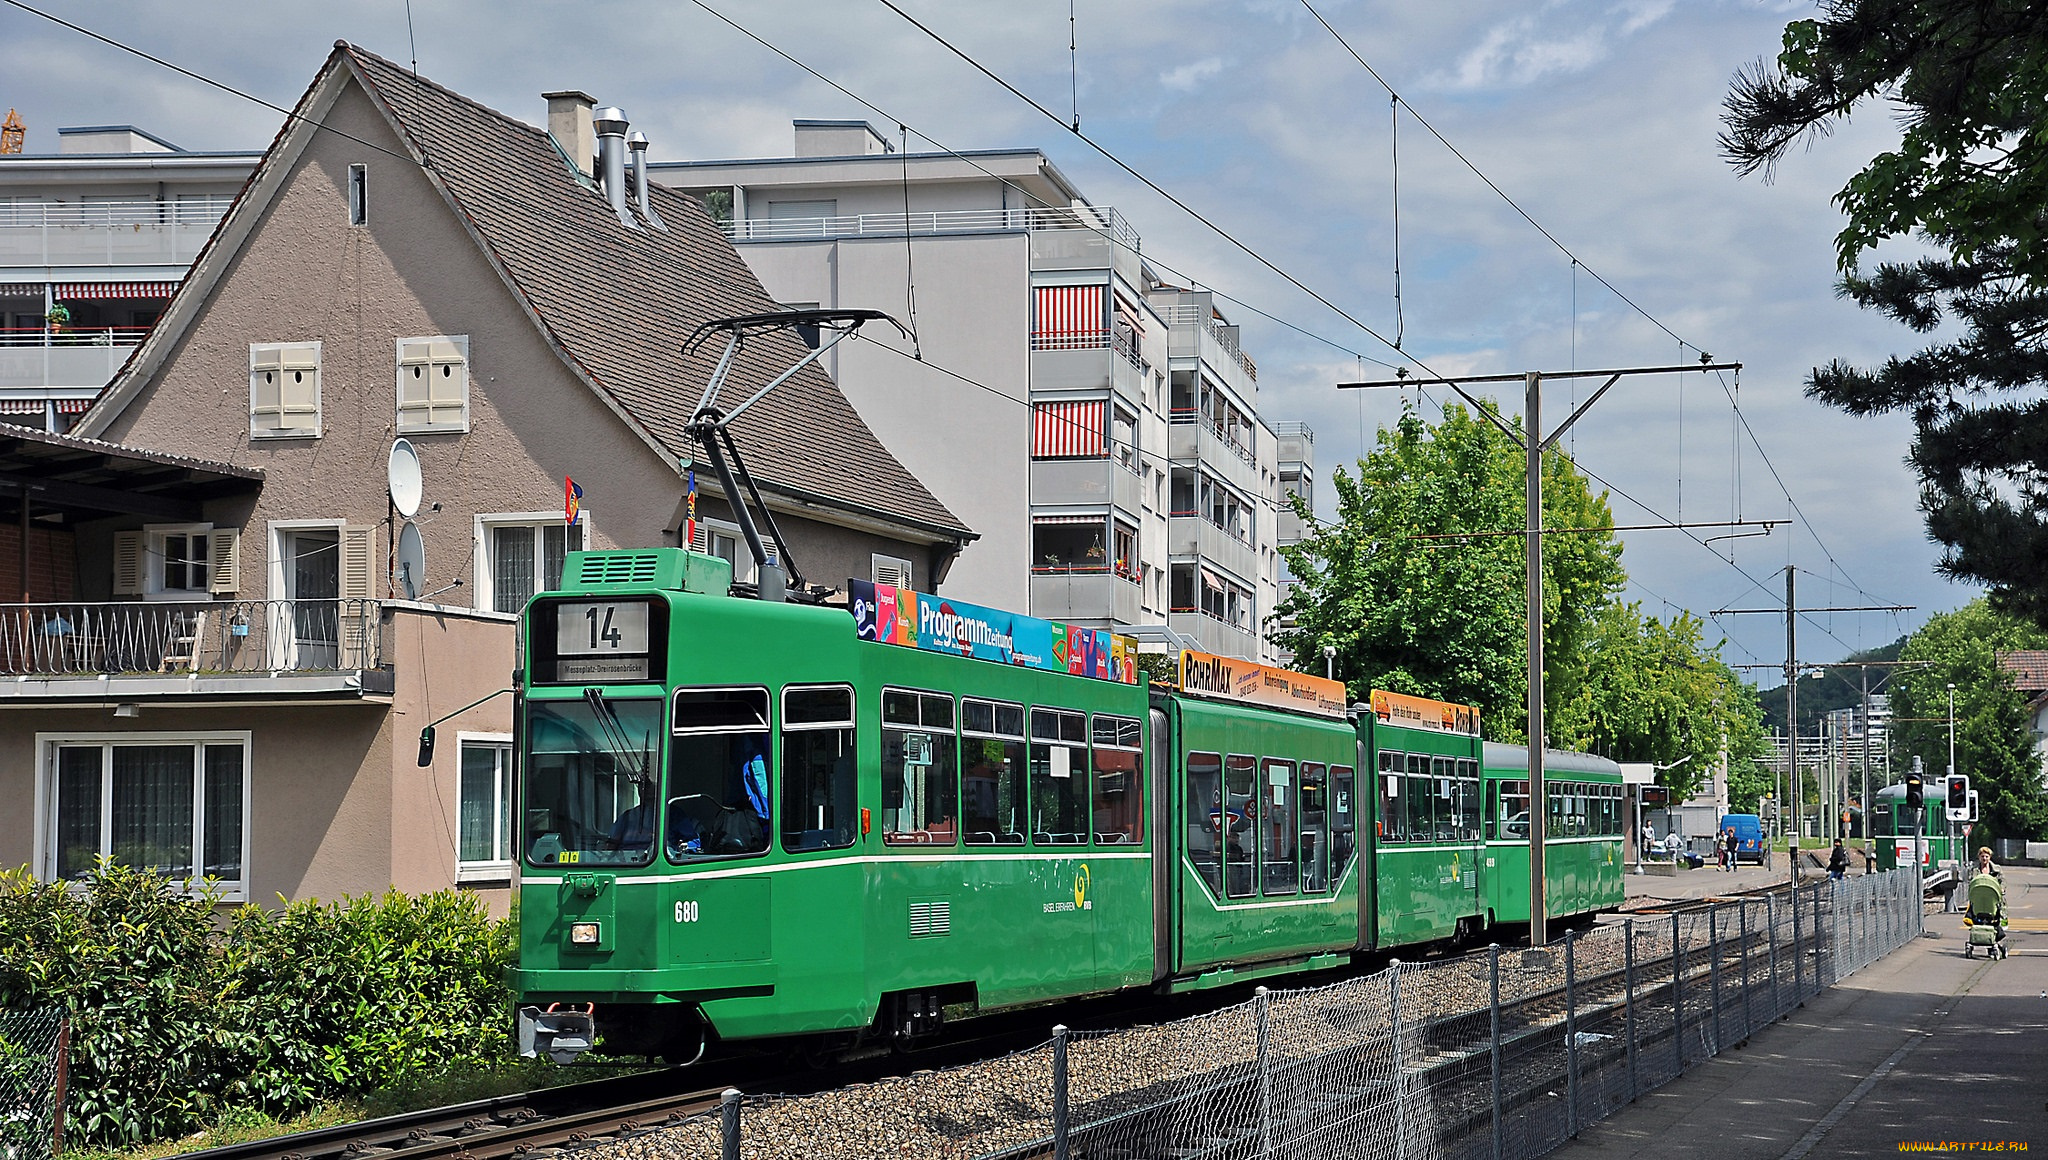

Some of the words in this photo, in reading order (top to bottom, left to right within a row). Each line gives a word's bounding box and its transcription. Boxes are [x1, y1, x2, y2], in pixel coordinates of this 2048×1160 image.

[880, 593, 895, 606] Jugend
[586, 607, 622, 649] 14
[564, 663, 643, 675] Messeplatz-Dreirosenbrücke
[674, 900, 699, 923] 680
